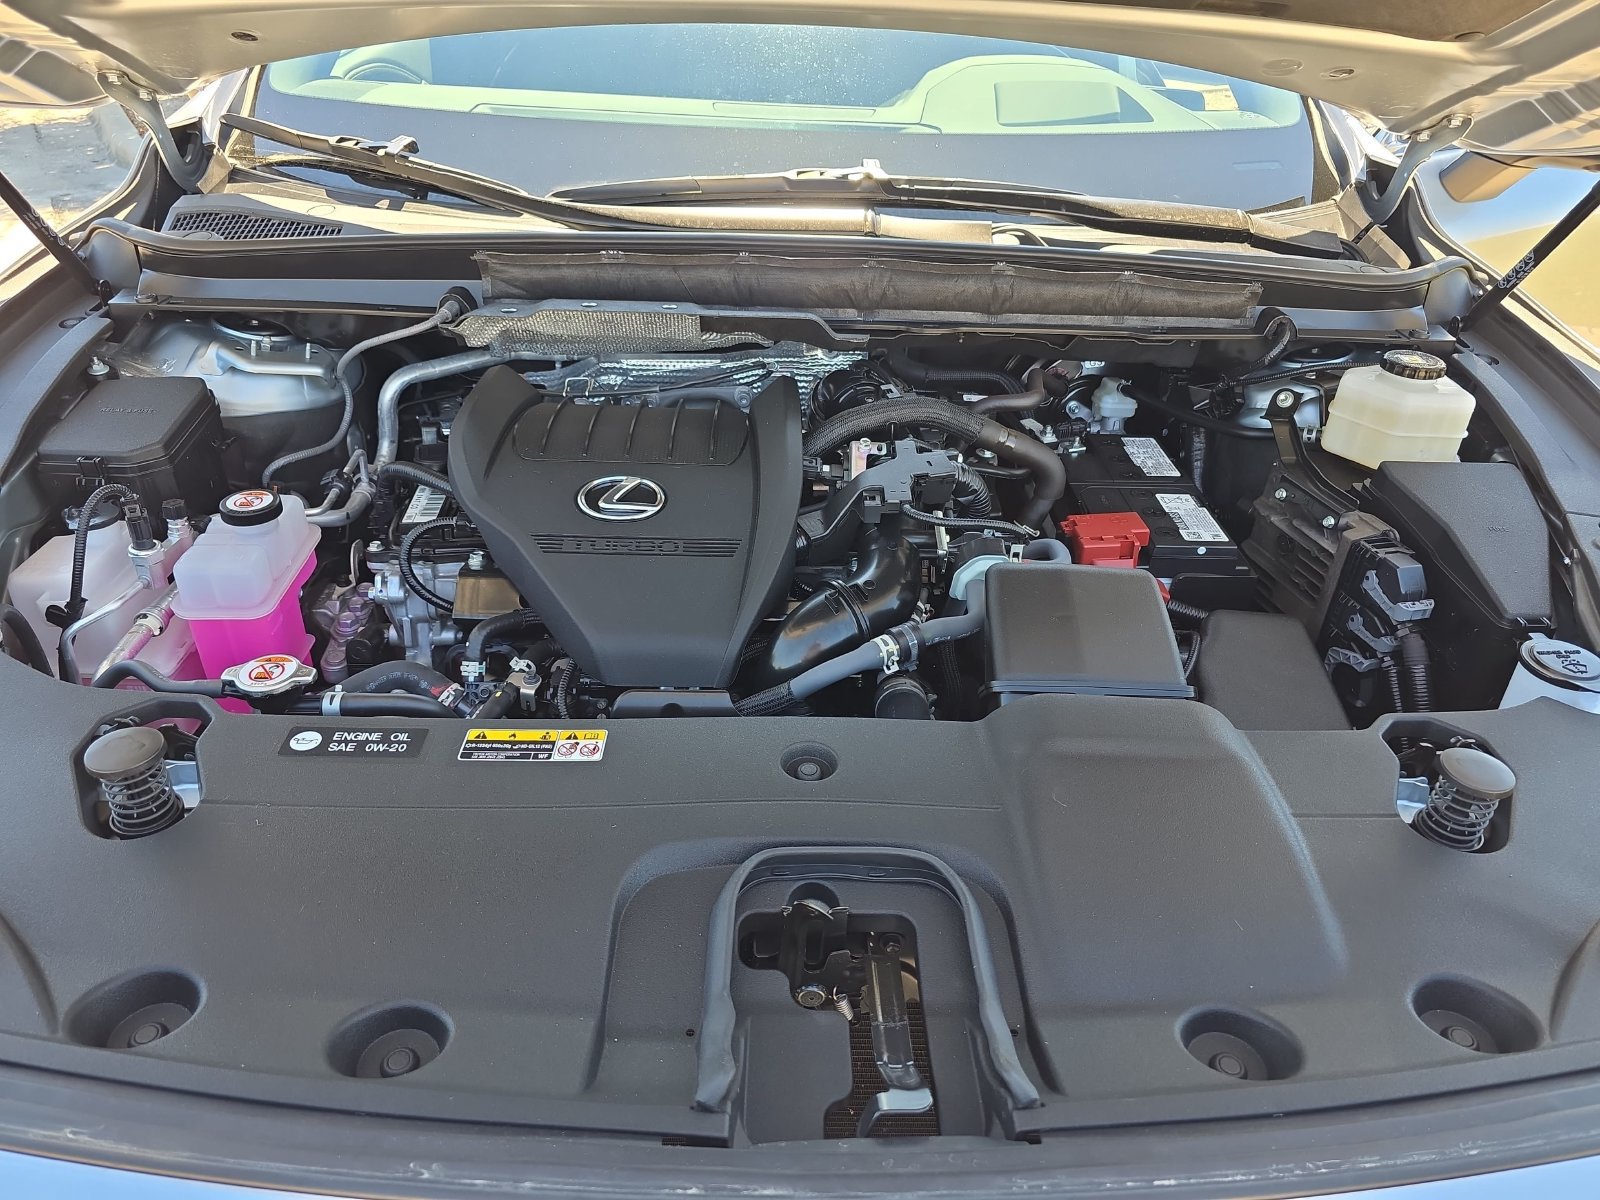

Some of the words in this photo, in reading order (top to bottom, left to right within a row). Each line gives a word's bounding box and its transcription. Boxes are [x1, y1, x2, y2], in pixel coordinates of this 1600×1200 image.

[567, 539, 680, 552] TURBO
[332, 731, 383, 741] ENGINE
[390, 732, 411, 741] OIL
[327, 742, 357, 752] SAE
[365, 743, 407, 752] 0W-20
